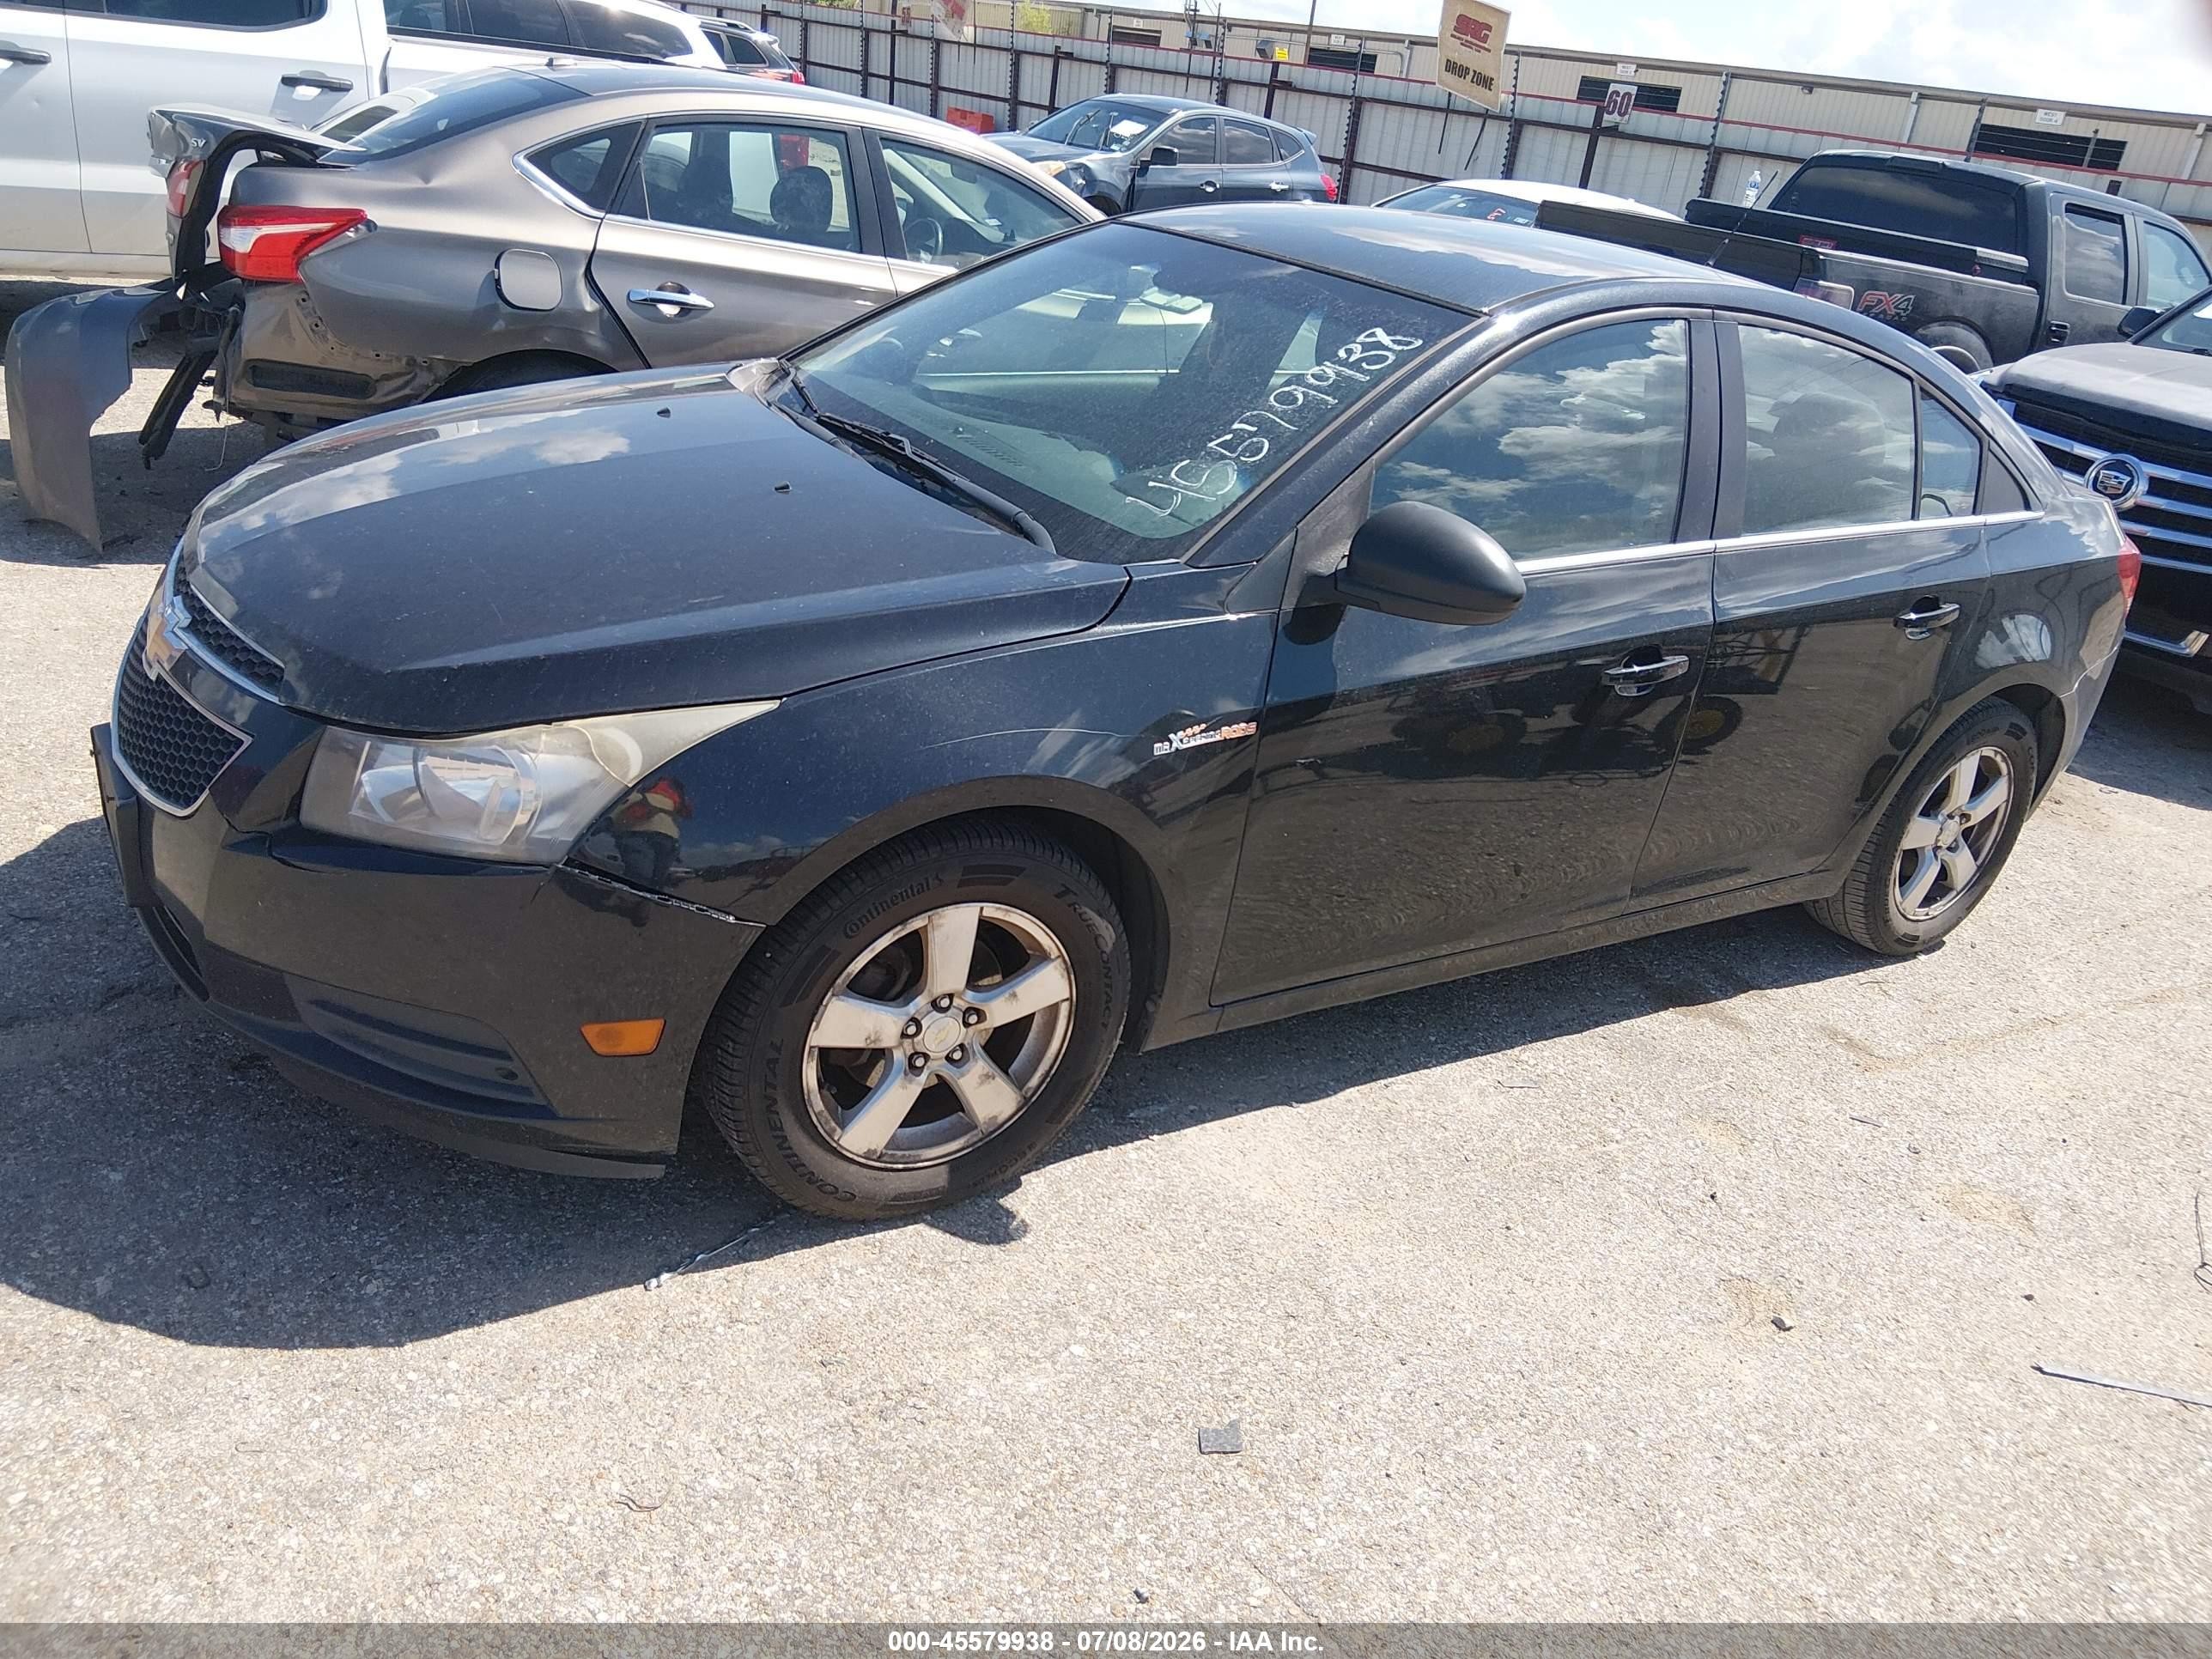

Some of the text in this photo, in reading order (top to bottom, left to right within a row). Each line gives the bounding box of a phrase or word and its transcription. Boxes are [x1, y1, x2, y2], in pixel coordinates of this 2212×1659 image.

[1444, 58, 1494, 91] DROP ZONE
[1605, 89, 1632, 117] 60
[191, 137, 206, 148] SV
[1856, 290, 1916, 316] FX4
[1125, 326, 1424, 517] 45579938
